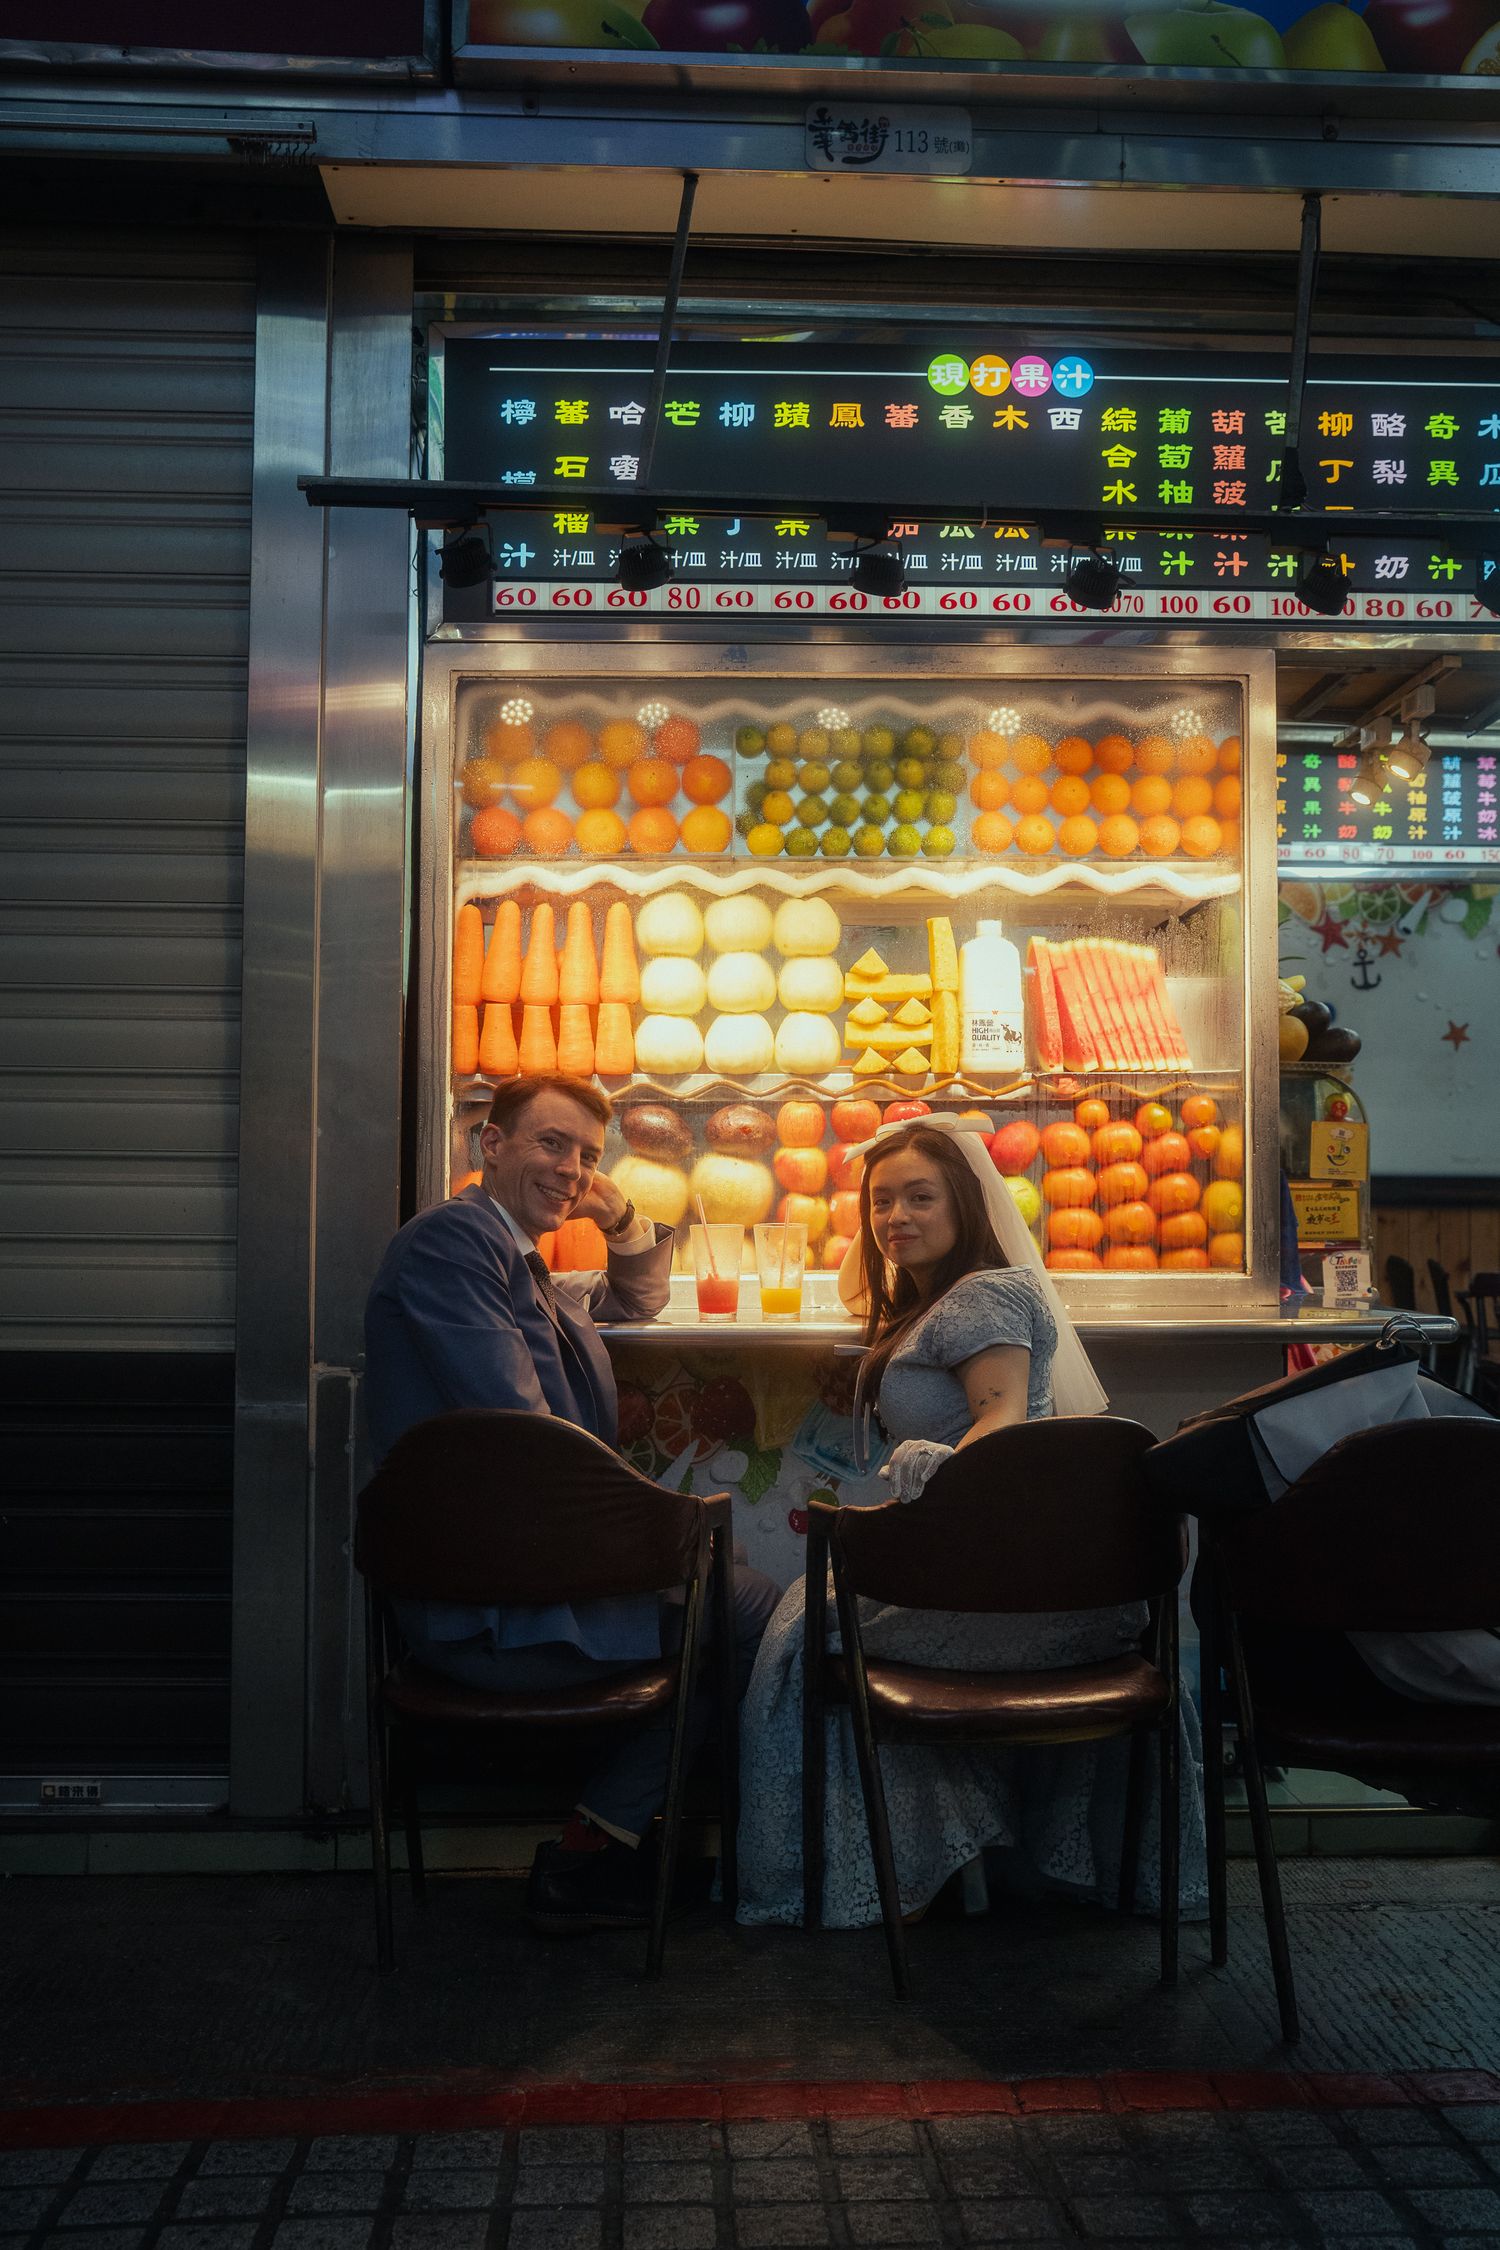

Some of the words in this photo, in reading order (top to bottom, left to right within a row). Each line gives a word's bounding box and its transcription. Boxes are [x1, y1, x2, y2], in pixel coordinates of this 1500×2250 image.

[931, 362, 1091, 390] 現打果汁
[1212, 410, 1248, 577] 葫蘿菠汁
[1371, 412, 1410, 580] 酪梨奶
[1425, 413, 1463, 580] 奇異汁
[496, 588, 537, 606] 60
[552, 588, 593, 607] 60
[607, 589, 648, 608] 60
[668, 587, 701, 609] 80
[715, 591, 754, 608] 60
[774, 590, 815, 609] 60
[829, 592, 868, 610] 60
[883, 591, 921, 609] 60
[939, 591, 978, 610] 60
[992, 593, 1032, 611] 60
[1160, 596, 1198, 614] 100
[1213, 595, 1251, 614] 60
[1271, 598, 1310, 616] 100
[1365, 599, 1405, 617] 80
[1416, 600, 1453, 618] 60
[1470, 601, 1500, 618] 7
[1305, 849, 1325, 858] 60
[1343, 849, 1360, 860] 80
[1378, 849, 1394, 860] 70
[1412, 850, 1433, 860] 100
[1445, 850, 1465, 860] 60
